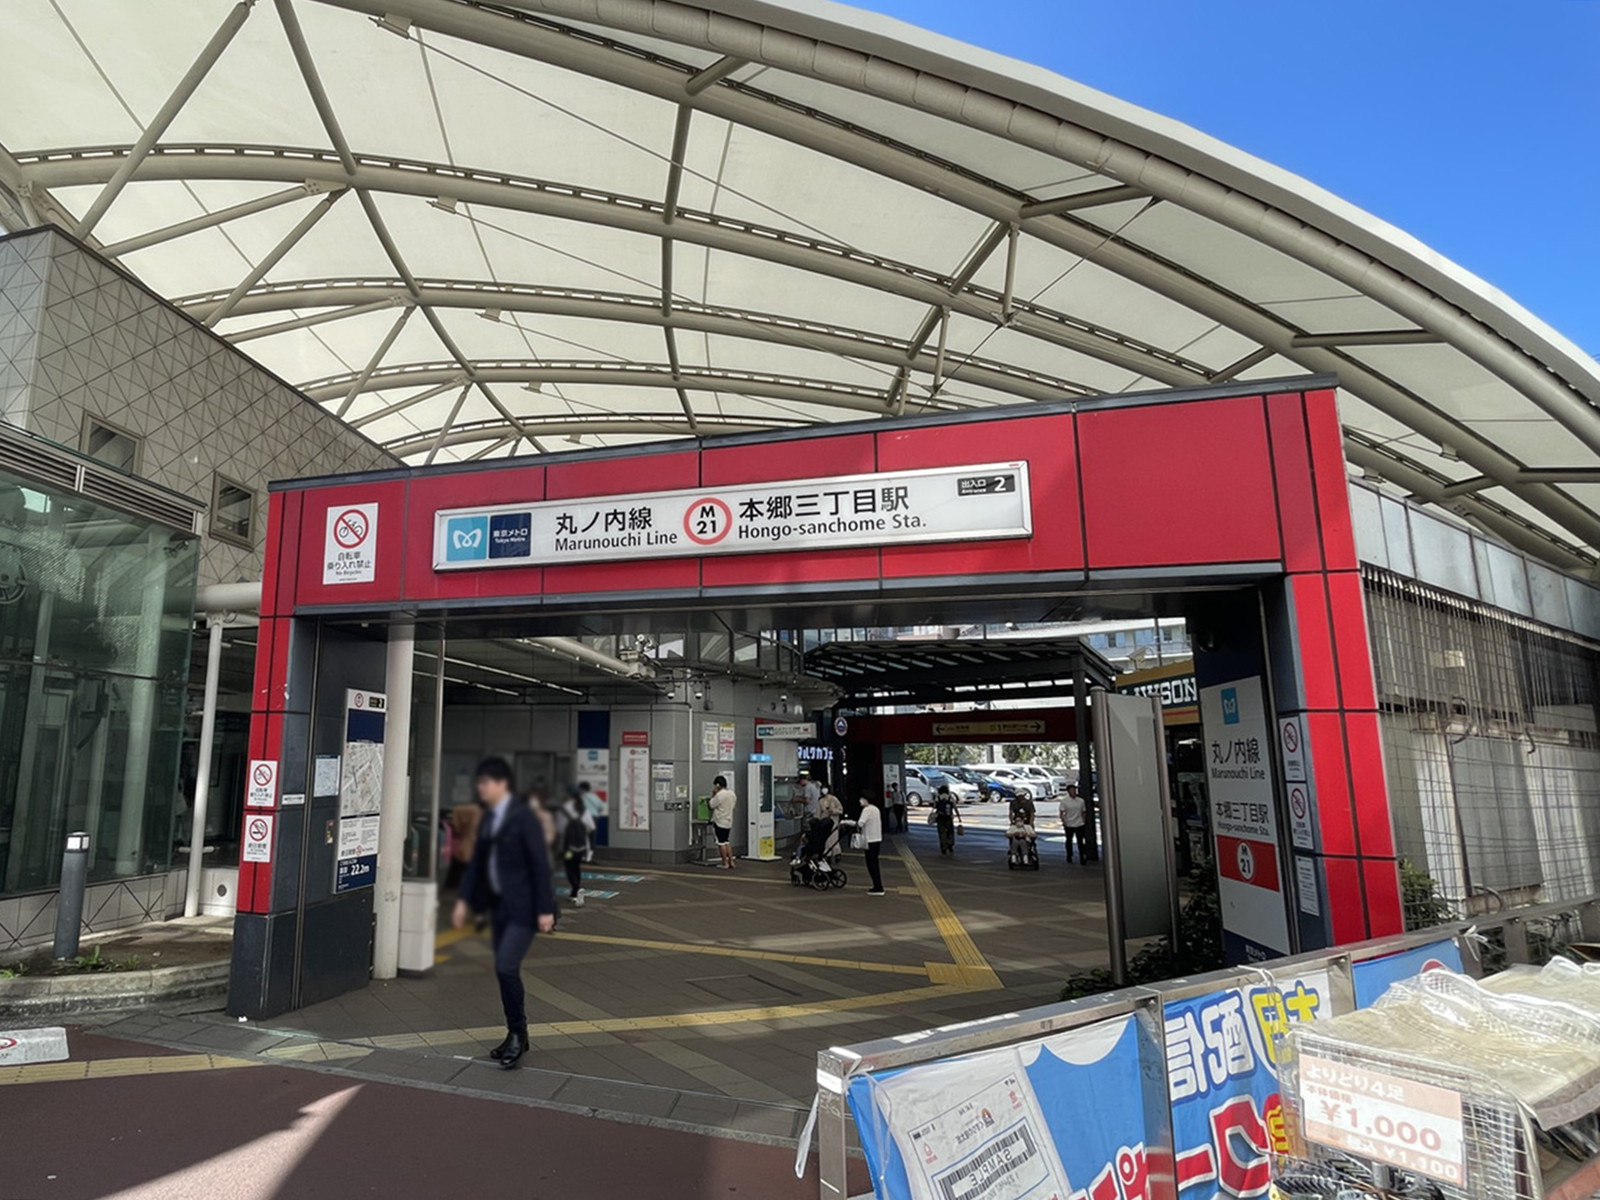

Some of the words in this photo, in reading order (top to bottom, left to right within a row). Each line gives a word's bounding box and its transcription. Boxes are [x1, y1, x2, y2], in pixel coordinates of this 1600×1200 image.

[994, 476, 1006, 492] 2
[700, 505, 715, 518] M
[738, 486, 909, 522] 本郷三丁目駅
[555, 506, 652, 535] 丸ノ内線
[697, 520, 717, 535] 21
[738, 515, 886, 541] Hongo-sanchome
[892, 513, 927, 530] Sta.
[555, 532, 642, 552] Marunouchi
[647, 529, 678, 547] Line
[1211, 737, 1261, 764] 丸ノ内線
[1211, 766, 1249, 779] Marunouchi
[1249, 767, 1266, 780] Line
[1215, 801, 1269, 824] 本郷三丁目駅
[1240, 858, 1251, 874] 21
